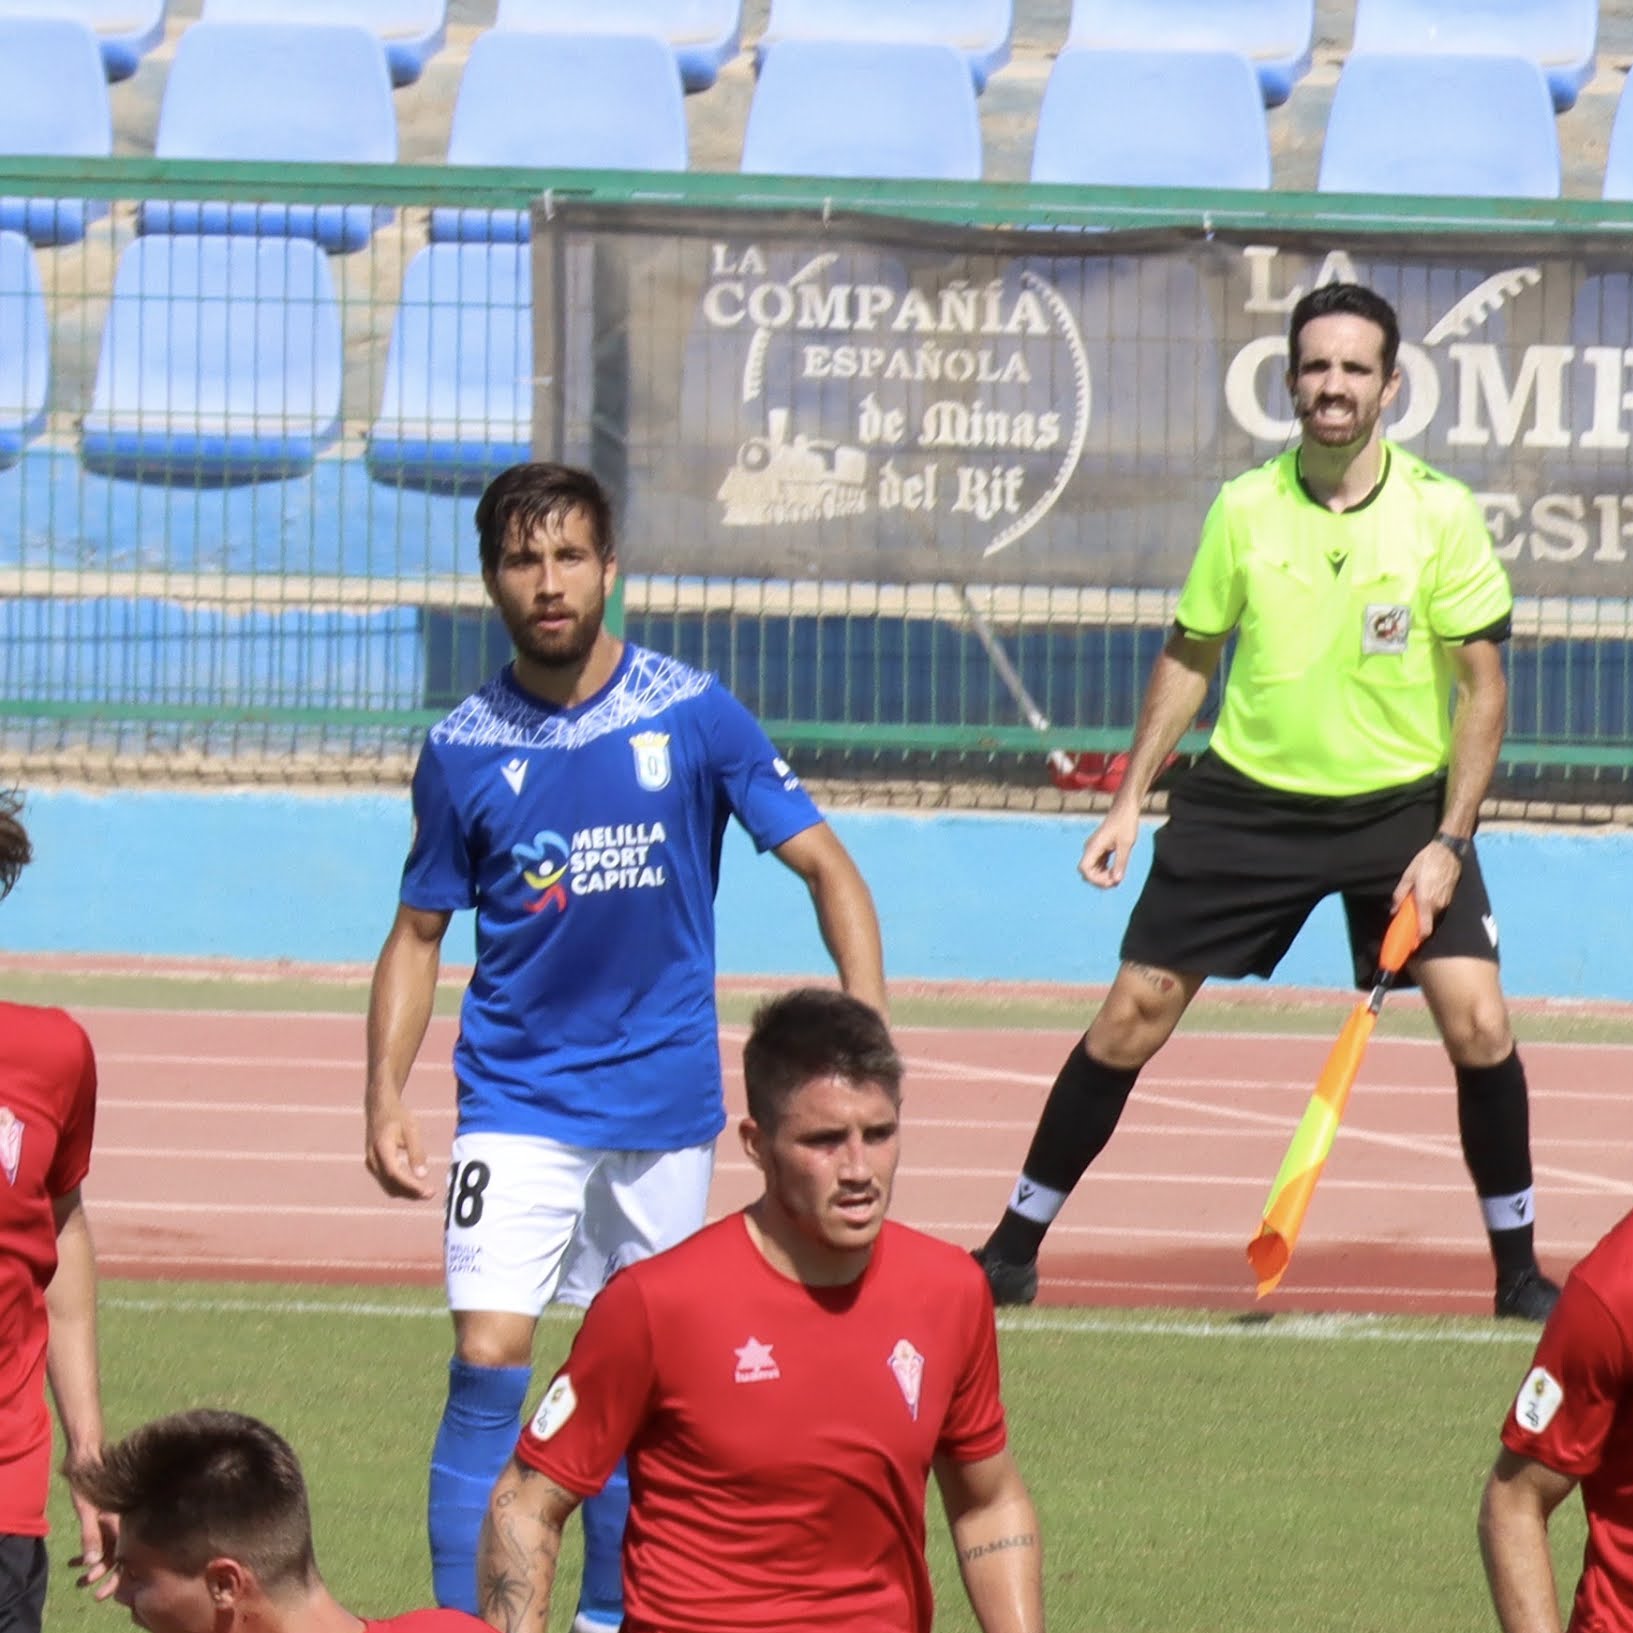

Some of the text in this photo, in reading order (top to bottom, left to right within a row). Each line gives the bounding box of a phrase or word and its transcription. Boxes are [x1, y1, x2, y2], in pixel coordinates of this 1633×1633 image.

[712, 244, 767, 275] LA
[703, 280, 1051, 335] COMPAÑÍA
[802, 341, 1032, 384] ESPAÑOLA
[858, 392, 1061, 450] de Minas
[878, 460, 937, 512] del
[571, 820, 666, 851] MELILLA
[570, 845, 650, 873] SPORT
[571, 864, 666, 895] CAPITAL
